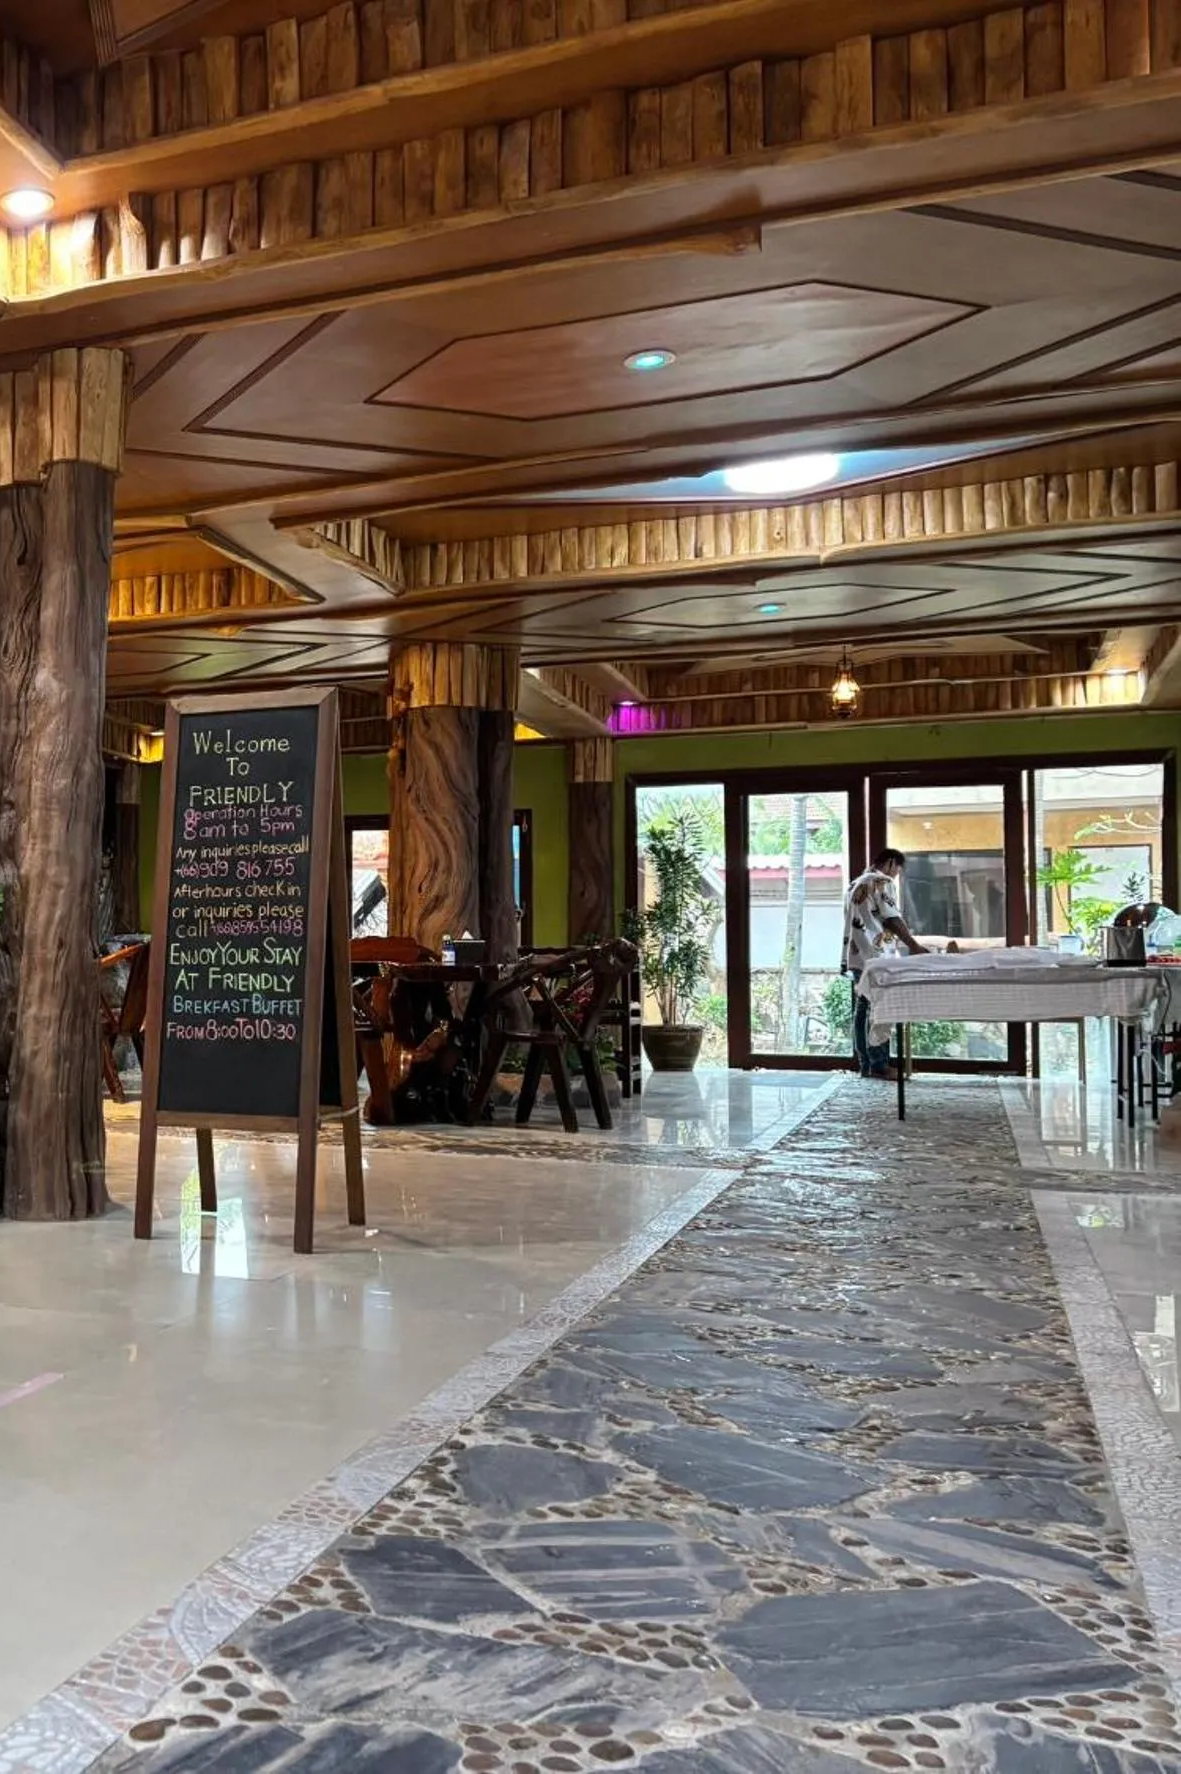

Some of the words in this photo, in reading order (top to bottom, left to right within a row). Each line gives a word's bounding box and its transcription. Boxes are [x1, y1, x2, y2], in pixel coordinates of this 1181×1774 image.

[193, 729, 291, 755] Welcome
[226, 757, 250, 776] To
[189, 781, 294, 807] FRIENDLY
[184, 805, 256, 824] Operation
[260, 804, 303, 819] Hours
[232, 820, 250, 837] to
[260, 818, 295, 837] 5pm
[176, 846, 197, 863] Any
[287, 882, 302, 896] in
[172, 906, 190, 919] or
[194, 902, 254, 924] inquiries
[258, 901, 305, 920] please
[176, 920, 208, 939] call
[170, 943, 218, 965] ENJOY
[216, 940, 259, 965] YOUR
[263, 937, 303, 966] STAY
[174, 968, 200, 991] AT
[209, 967, 295, 993] FRIENDLY
[173, 995, 250, 1014] BREKFAST
[252, 993, 303, 1016] BUFFET
